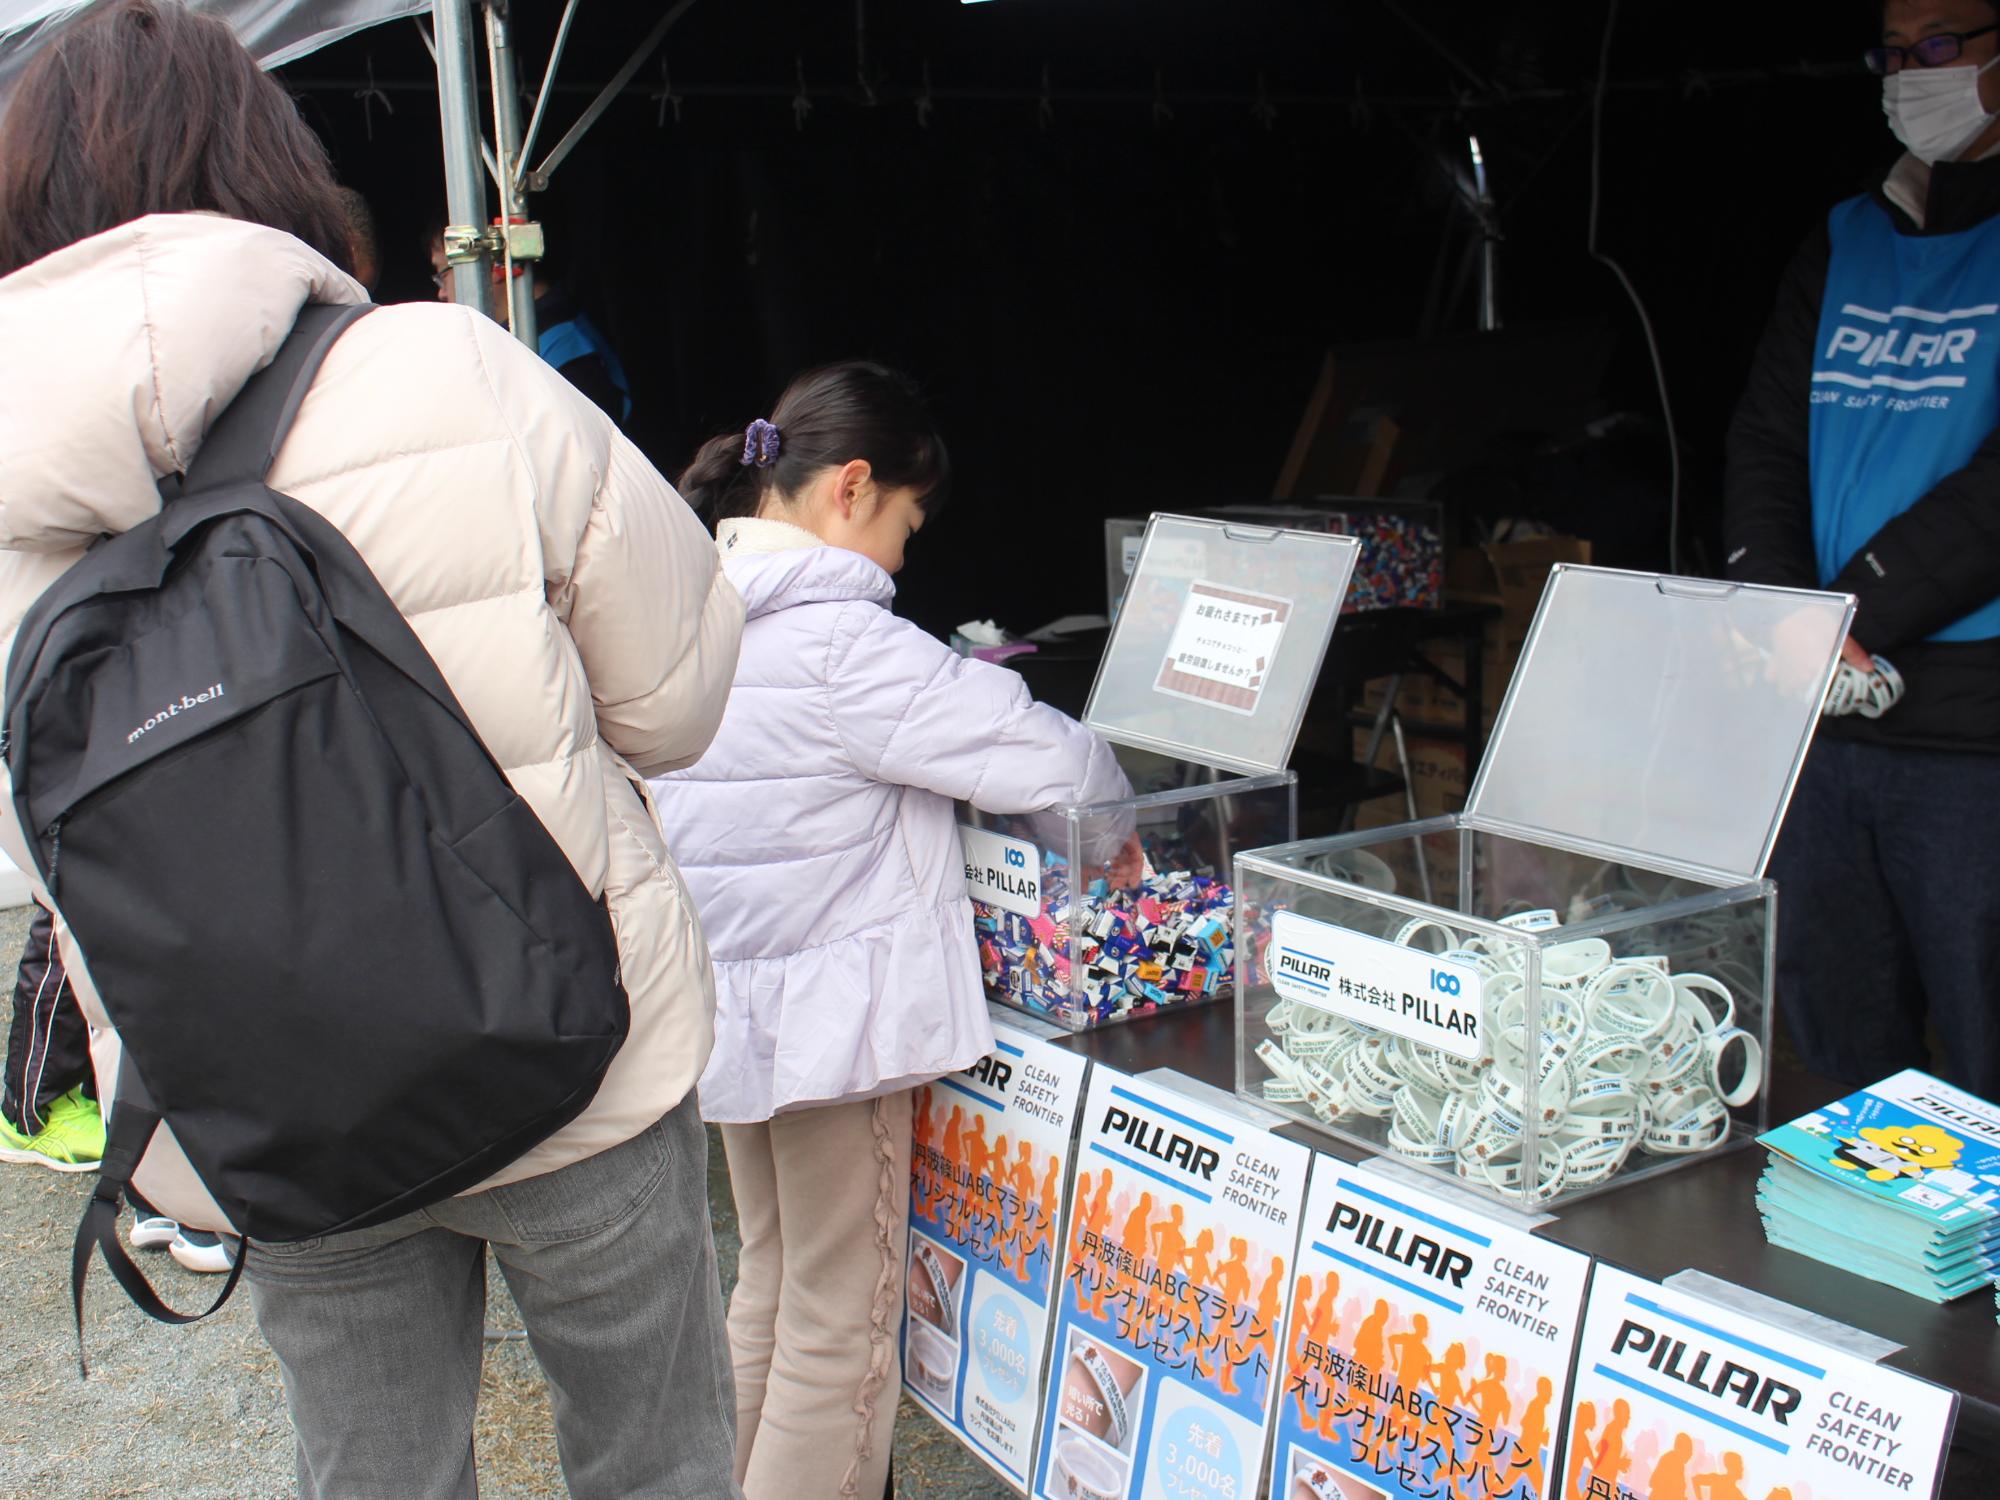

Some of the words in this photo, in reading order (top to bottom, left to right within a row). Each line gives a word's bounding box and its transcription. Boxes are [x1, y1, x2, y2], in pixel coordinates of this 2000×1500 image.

[1005, 847, 1025, 868] 100
[965, 864, 984, 884] 会社
[987, 867, 1037, 901] PILLAR
[1280, 955, 1331, 982] PILLAR
[1430, 968, 1460, 996] 100
[1339, 975, 1396, 1013] 株式会社
[1402, 992, 1477, 1039] PILLAR
[1018, 1080, 1059, 1105] SAFETY
[1024, 1064, 1060, 1088] CLEAN
[1013, 1096, 1064, 1128] FRONTIER
[1911, 1097, 2000, 1135] PILLA
[1101, 1106, 1220, 1182] PILLAR
[915, 1142, 1049, 1230] 丹波篠山ABCマラソン
[1228, 1169, 1281, 1201] SAFETY
[1236, 1152, 1280, 1181] CLEAN
[1222, 1186, 1288, 1225] FRONTIER
[1326, 1201, 1473, 1289] PILLAR
[1082, 1231, 1267, 1338] 丹波篠山ABCマラソン
[1484, 1276, 1550, 1312] SAFETY
[1493, 1258, 1550, 1291] CLEAN
[1070, 1263, 1270, 1378] オリジナルリストバンド
[1477, 1296, 1559, 1341] FRONTIER
[1116, 1318, 1206, 1380] プレゼント
[1610, 1319, 1802, 1427] PILLAR
[1303, 1340, 1533, 1468] 丹波篠山ABCマラソン
[1829, 1391, 1902, 1431] CLEAN
[1187, 1422, 1222, 1458] 先着
[1817, 1413, 1901, 1456] SAFETY
[1165, 1443, 1236, 1500] 3,000名
[1806, 1434, 1915, 1492] FRONTIER
